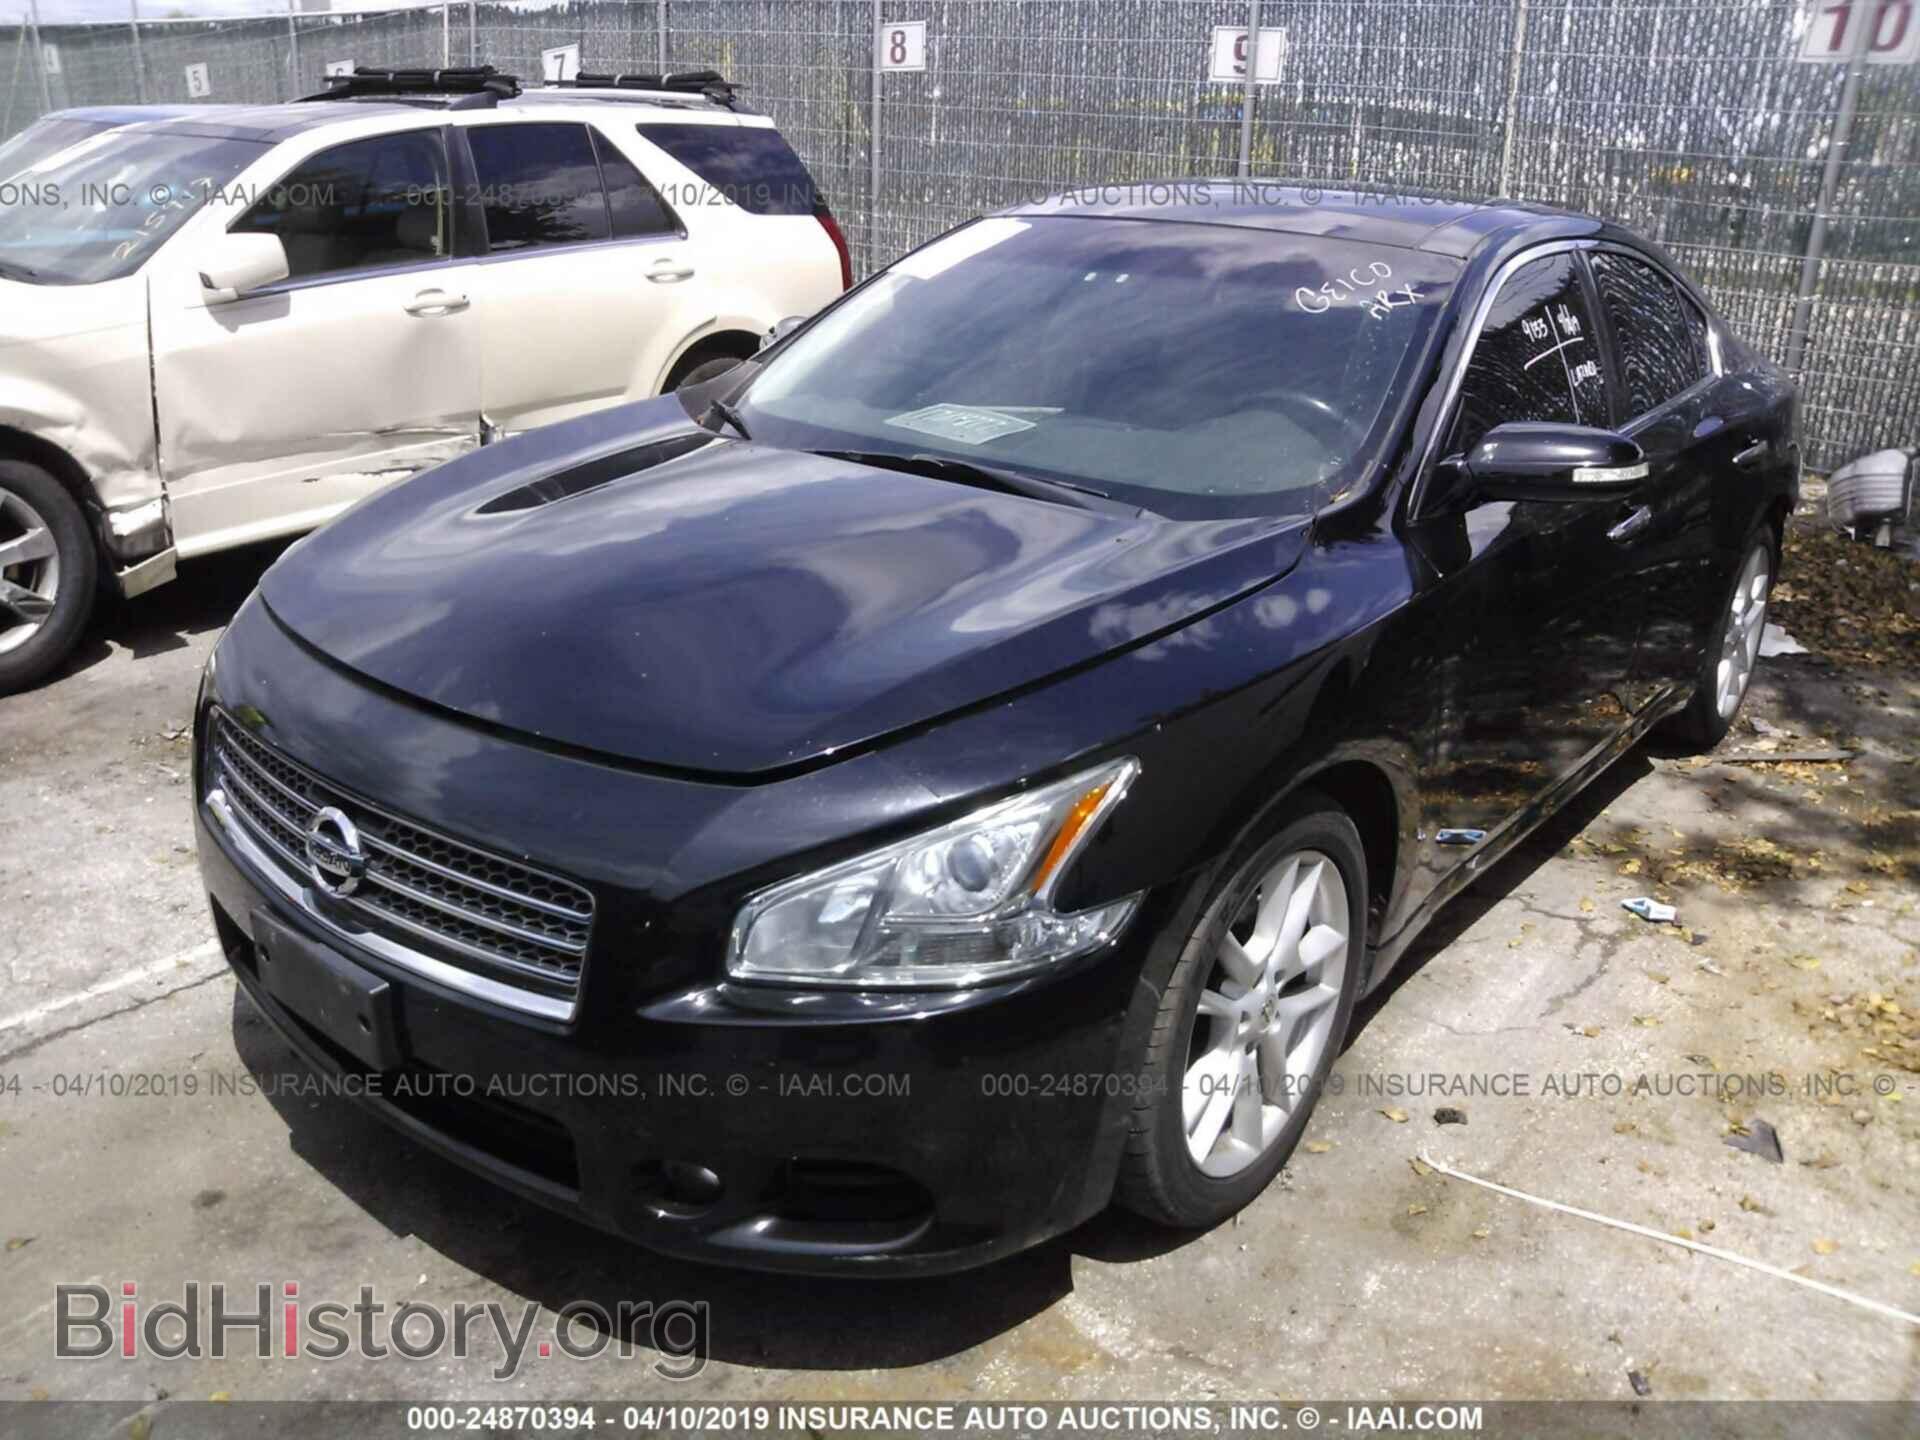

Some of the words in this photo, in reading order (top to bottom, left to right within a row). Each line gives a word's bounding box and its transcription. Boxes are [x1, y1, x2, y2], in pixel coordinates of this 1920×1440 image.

[1823, 0, 1914, 52] 10
[890, 30, 907, 64] 8
[1233, 34, 1249, 74] 9
[192, 69, 202, 92] 5
[553, 53, 567, 82] 7
[1295, 261, 1392, 313] GEICO
